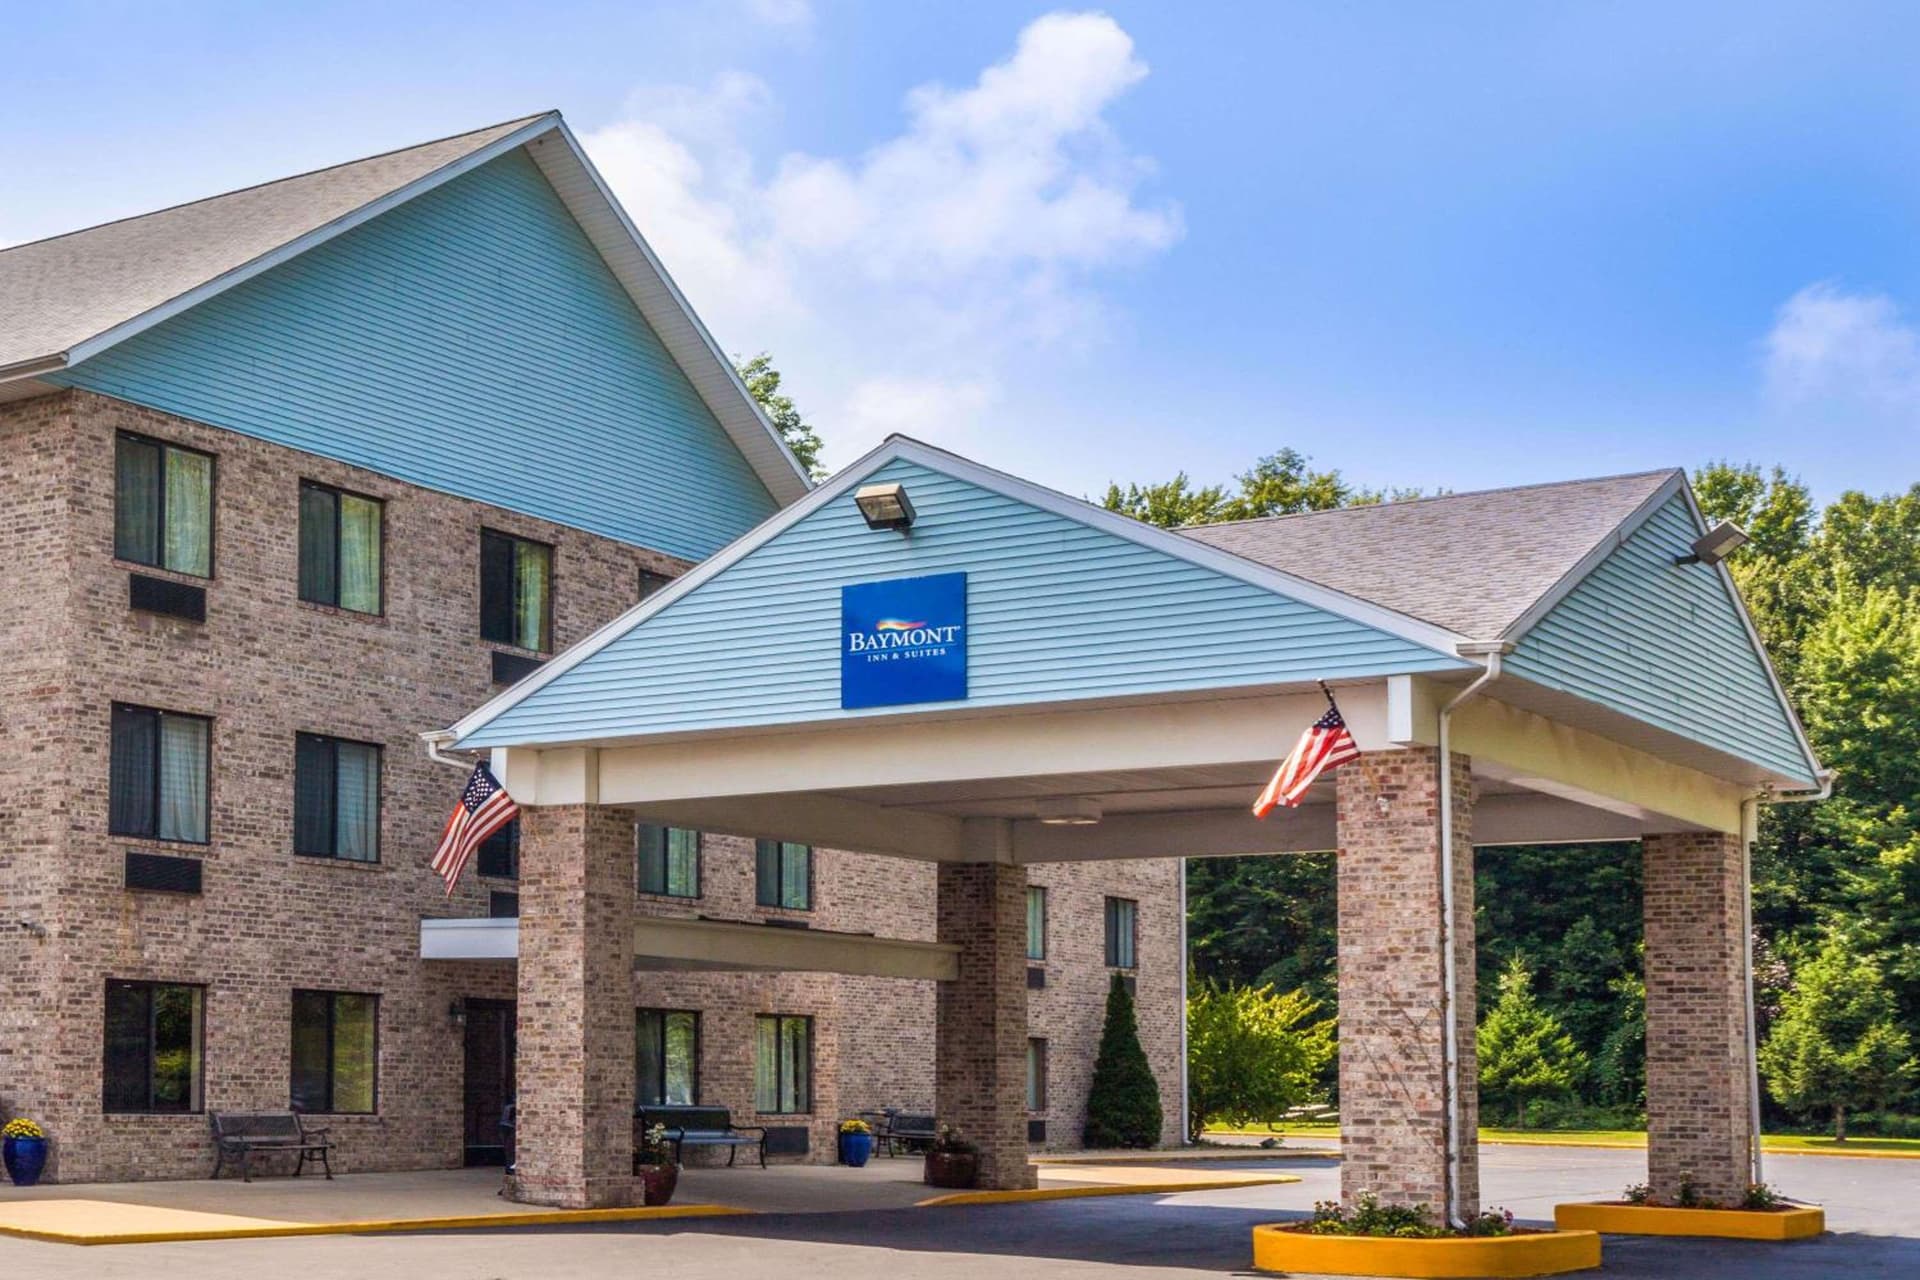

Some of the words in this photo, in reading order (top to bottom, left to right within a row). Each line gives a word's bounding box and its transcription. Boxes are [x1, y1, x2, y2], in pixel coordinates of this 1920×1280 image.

[849, 625, 960, 652] BAYMONT
[867, 654, 888, 663] INN
[892, 652, 900, 660] &
[904, 648, 947, 660] SUITES
